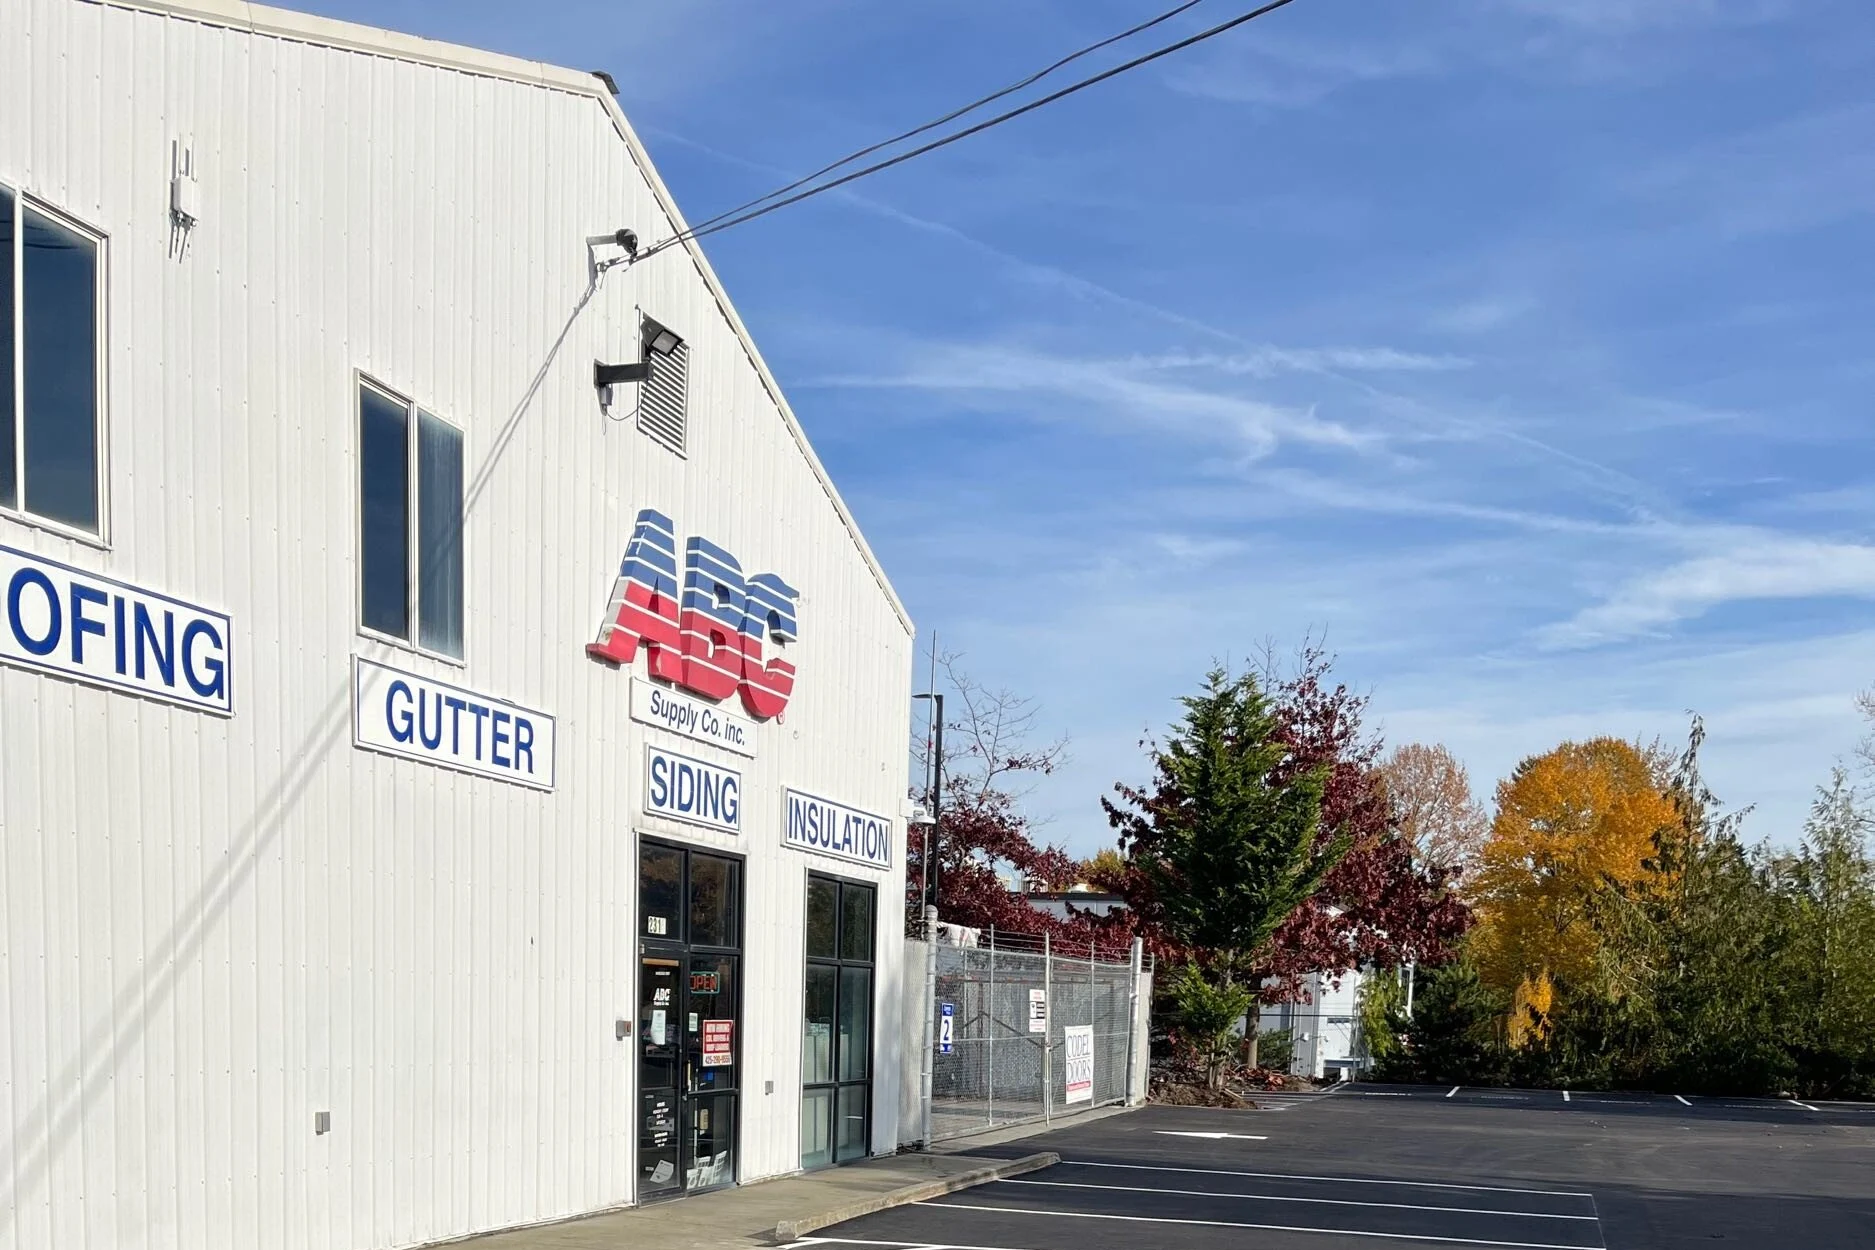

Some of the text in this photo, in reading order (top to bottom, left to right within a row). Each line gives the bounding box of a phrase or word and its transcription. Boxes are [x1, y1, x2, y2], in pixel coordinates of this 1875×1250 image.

[7, 566, 224, 700] OFING
[585, 508, 799, 717] ABC
[385, 680, 534, 775] GUTTER
[650, 690, 745, 746] Supply Co. inc.
[650, 756, 739, 825] SIDING
[788, 797, 888, 859] INSULATION
[653, 987, 671, 1001] ABC
[943, 1019, 950, 1041] 2
[1067, 1059, 1091, 1083] DOORS
